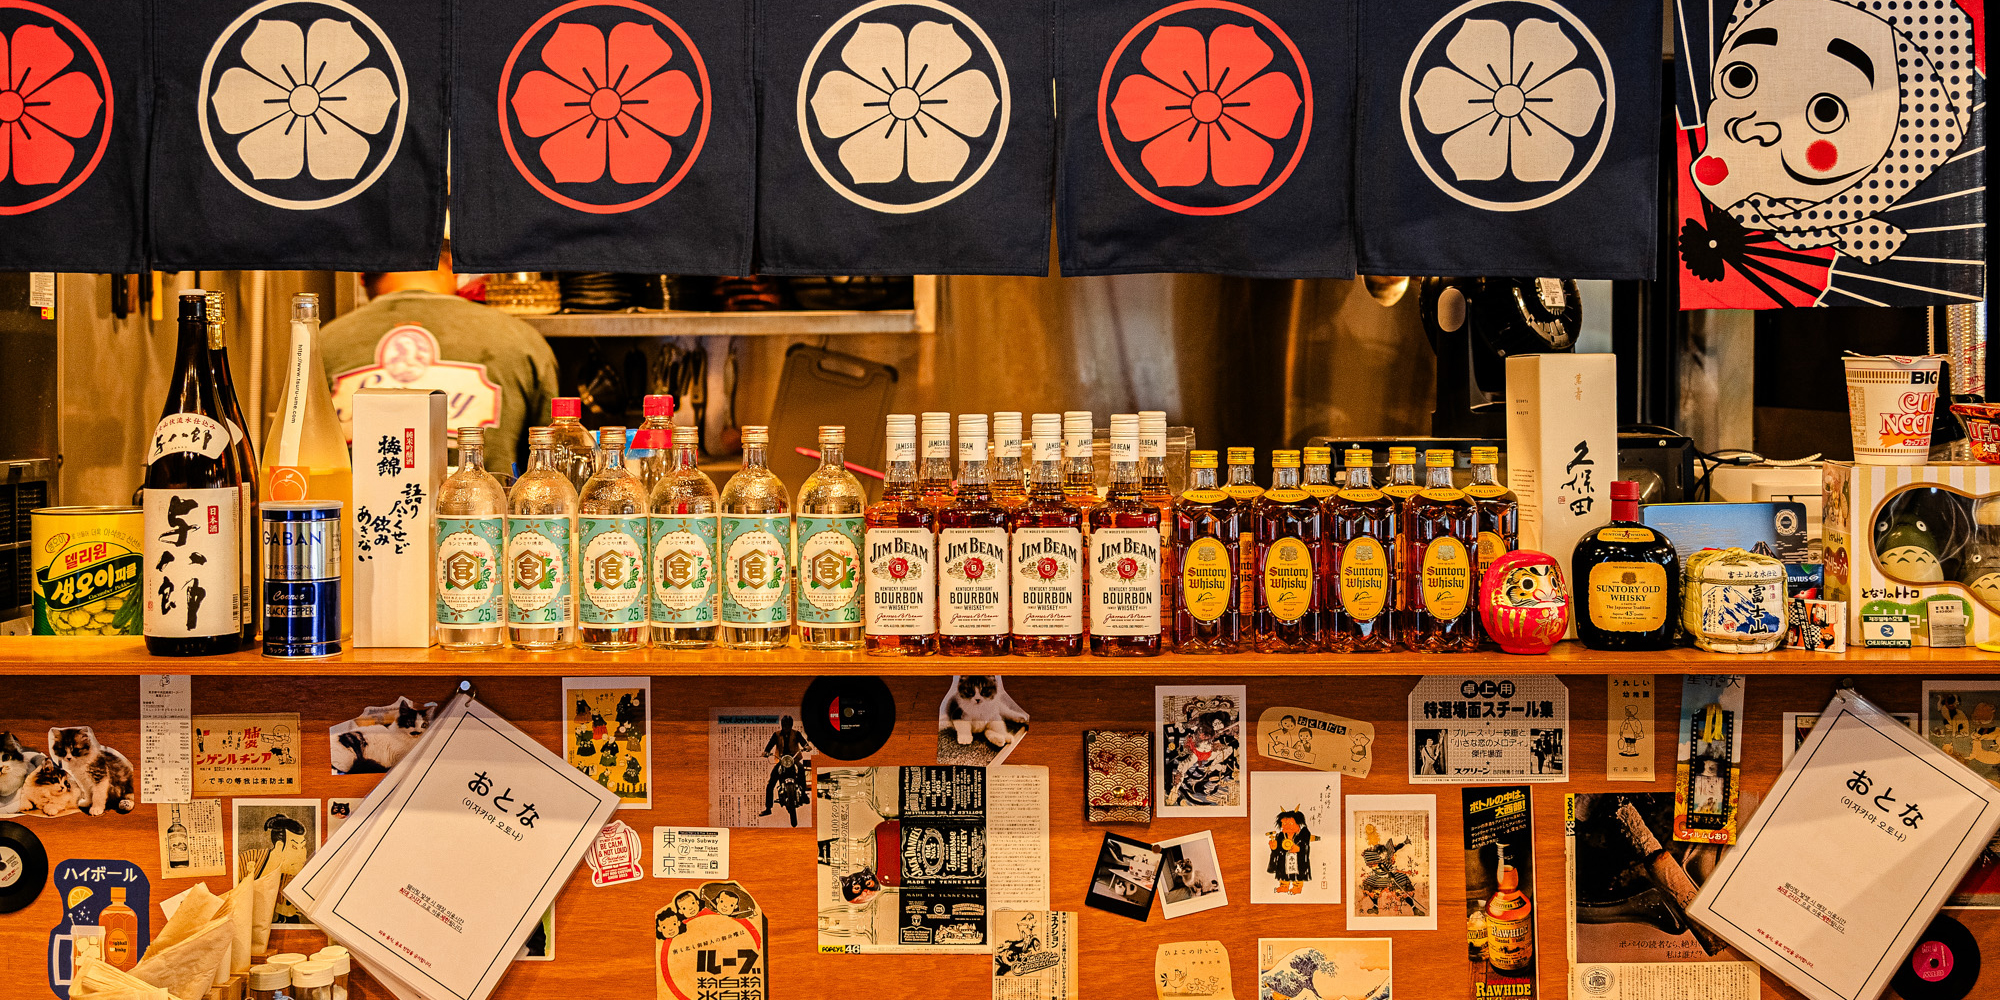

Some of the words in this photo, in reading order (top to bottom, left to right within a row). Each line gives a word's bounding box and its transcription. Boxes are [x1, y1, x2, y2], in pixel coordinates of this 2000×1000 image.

[1911, 371, 1937, 384] BIG
[377, 435, 402, 477] 梅錦
[1560, 439, 1595, 517] 久保田
[400, 483, 427, 519] 語り
[208, 507, 218, 533] 日本酒
[388, 500, 411, 555] 尽くせど
[357, 505, 373, 562] あきない
[370, 515, 391, 546] 飲み
[263, 531, 322, 546] GABAN
[65, 542, 107, 570] 델리원
[870, 541, 893, 563] JIM
[894, 537, 929, 564] BEAM
[946, 541, 968, 563] JIM
[970, 537, 1004, 564] BEAM
[1019, 541, 1042, 563] JIM
[1043, 537, 1078, 564] BEAM
[1098, 541, 1121, 563] JIM
[1122, 537, 1157, 564] BEAM
[1187, 567, 1227, 578] Suntory
[1268, 566, 1308, 579] Suntory
[1344, 566, 1384, 578] Suntory
[1426, 566, 1466, 578] Suntory
[50, 562, 137, 605] 생오이피클
[88, 588, 113, 600] Cucumber
[114, 581, 131, 591] Pickles
[1188, 578, 1225, 590] Whisky
[1269, 578, 1307, 590] Whisky
[1345, 578, 1382, 590] Whisky
[1427, 578, 1465, 590] Whisky
[1596, 585, 1639, 593] SUNTORY
[1642, 585, 1660, 593] OLD
[874, 592, 923, 604] BOURBON
[950, 592, 998, 604] BOURBON
[1023, 592, 1072, 604] BOURBON
[1102, 592, 1151, 604] BOURBON
[1862, 586, 1920, 599] となりのトトロ
[266, 607, 286, 616] BLACK
[287, 607, 314, 616] PEPPER
[1748, 585, 1769, 634] 富士山
[1461, 681, 1514, 697] 卓上用
[1613, 679, 1650, 687] うれしい
[1424, 701, 1553, 719] 特選場面スチール集
[1297, 715, 1347, 736] おともだち
[1471, 750, 1503, 758] 傑作場面
[467, 770, 541, 829] おとな
[1469, 789, 1526, 812] ボトルの中は、
[1846, 769, 1924, 830] おとな
[462, 796, 497, 825] (이자카야
[496, 821, 524, 842] 오토나)
[1840, 795, 1877, 824] (이자카야
[1876, 821, 1907, 843] 오토나)
[904, 826, 923, 858] DANIEL'S
[1681, 830, 1728, 841] フィルムしおり
[604, 849, 614, 857] NOT
[614, 846, 628, 854] LOUD
[608, 840, 624, 849] CALM
[663, 828, 676, 875] 東京
[680, 845, 689, 853] 72
[946, 831, 957, 871] Tennessee
[63, 866, 138, 882] ハイボール
[907, 858, 924, 877] JACK
[1492, 925, 1528, 938] RAWHIDE
[845, 945, 860, 954] 46
[1164, 948, 1219, 956] ひよこのけいこ
[697, 976, 761, 989] 粉白粉
[1476, 982, 1531, 997] RAWHIDE
